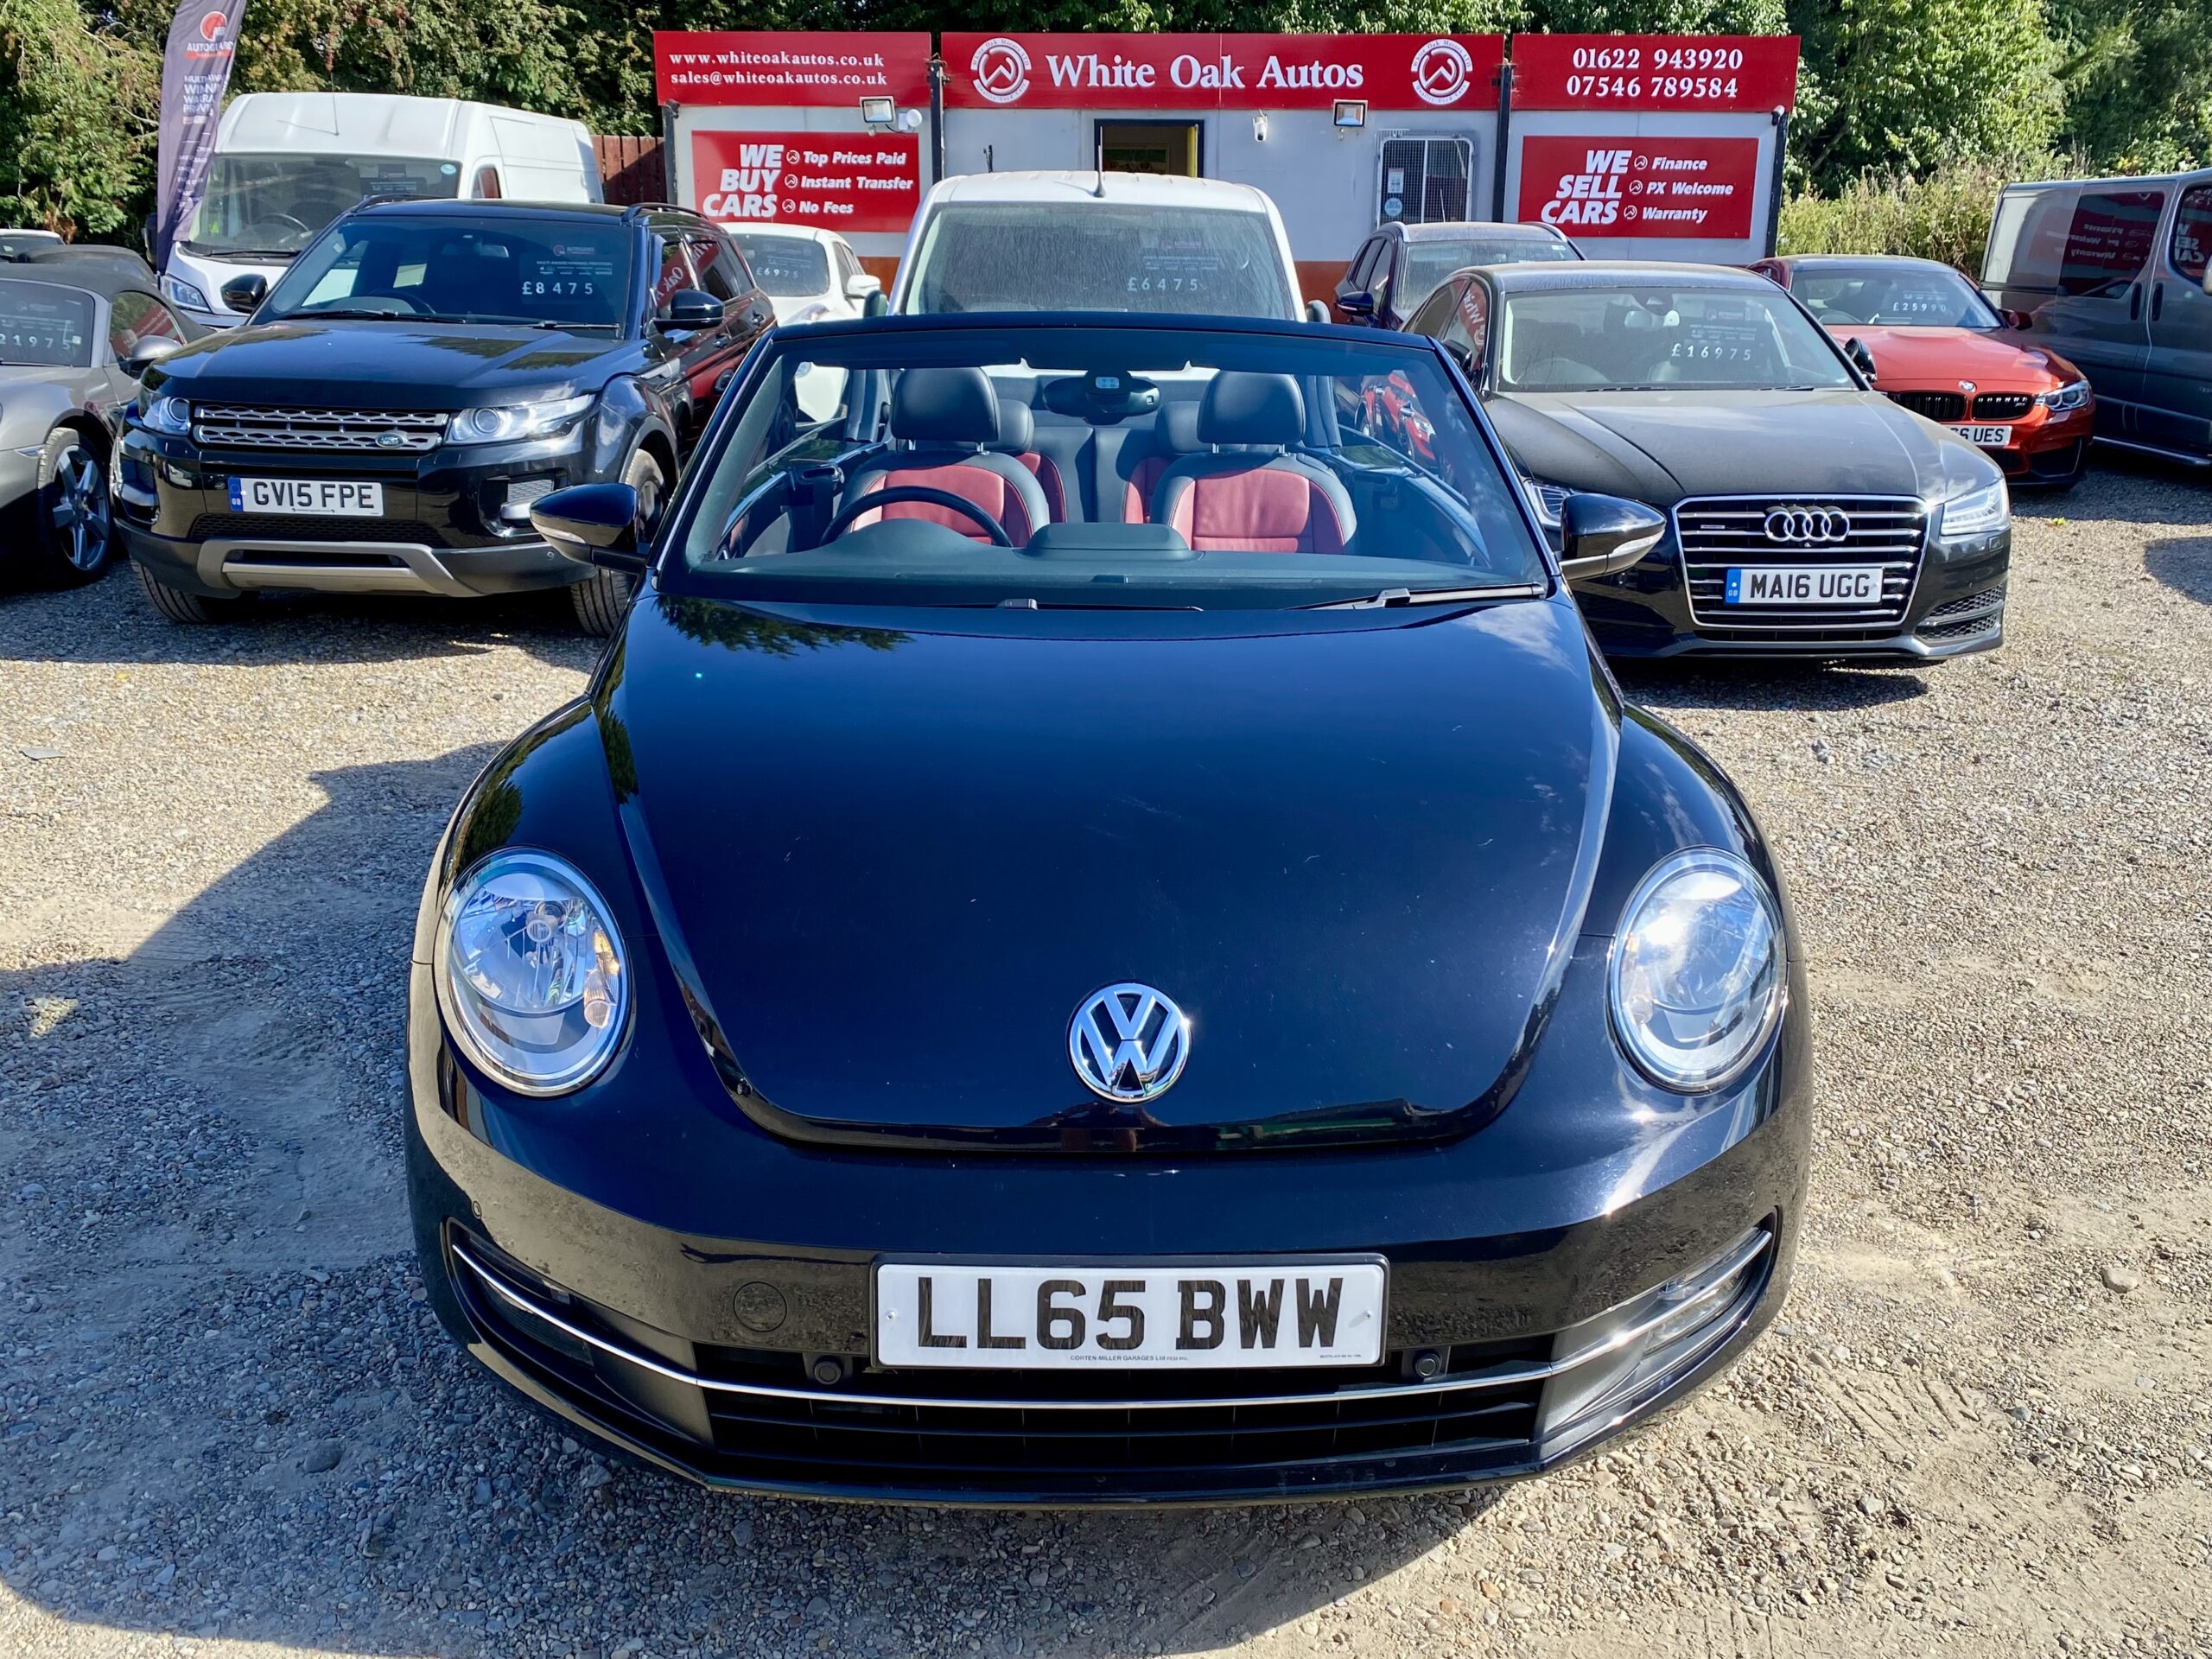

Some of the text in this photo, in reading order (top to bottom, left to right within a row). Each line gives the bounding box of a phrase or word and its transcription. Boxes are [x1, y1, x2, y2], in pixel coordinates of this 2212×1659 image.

[669, 51, 884, 67] www.whiteoakautos.co.uk
[1573, 48, 1744, 70] 01622 943920
[671, 71, 887, 85] sales@whiteoakautos.co.uk
[1046, 54, 1363, 88] White Oak Autos
[1567, 75, 1738, 98] 07546 789584
[740, 144, 785, 168] WE
[803, 150, 906, 167] Top Prices Paid
[1586, 149, 1632, 175] WE
[1651, 156, 1708, 170] Finance
[720, 169, 781, 193] BUY
[801, 175, 913, 189] Instant Transfer
[1555, 175, 1622, 199] SELL
[1646, 181, 1734, 195] PX Welcome
[702, 194, 778, 218] CARS
[798, 200, 854, 214] No Fees
[1541, 200, 1620, 225] CARS
[1642, 207, 1708, 225] Warranty
[756, 267, 798, 278] £6975
[522, 281, 594, 295] £8475
[1127, 277, 1198, 291] £6475
[1671, 343, 1751, 360] £16975
[1974, 428, 2005, 442] UES
[253, 481, 374, 509] GV15 FPE
[1750, 574, 1871, 599] MA16 UGG
[918, 1276, 1344, 1351] LL65 BWW
